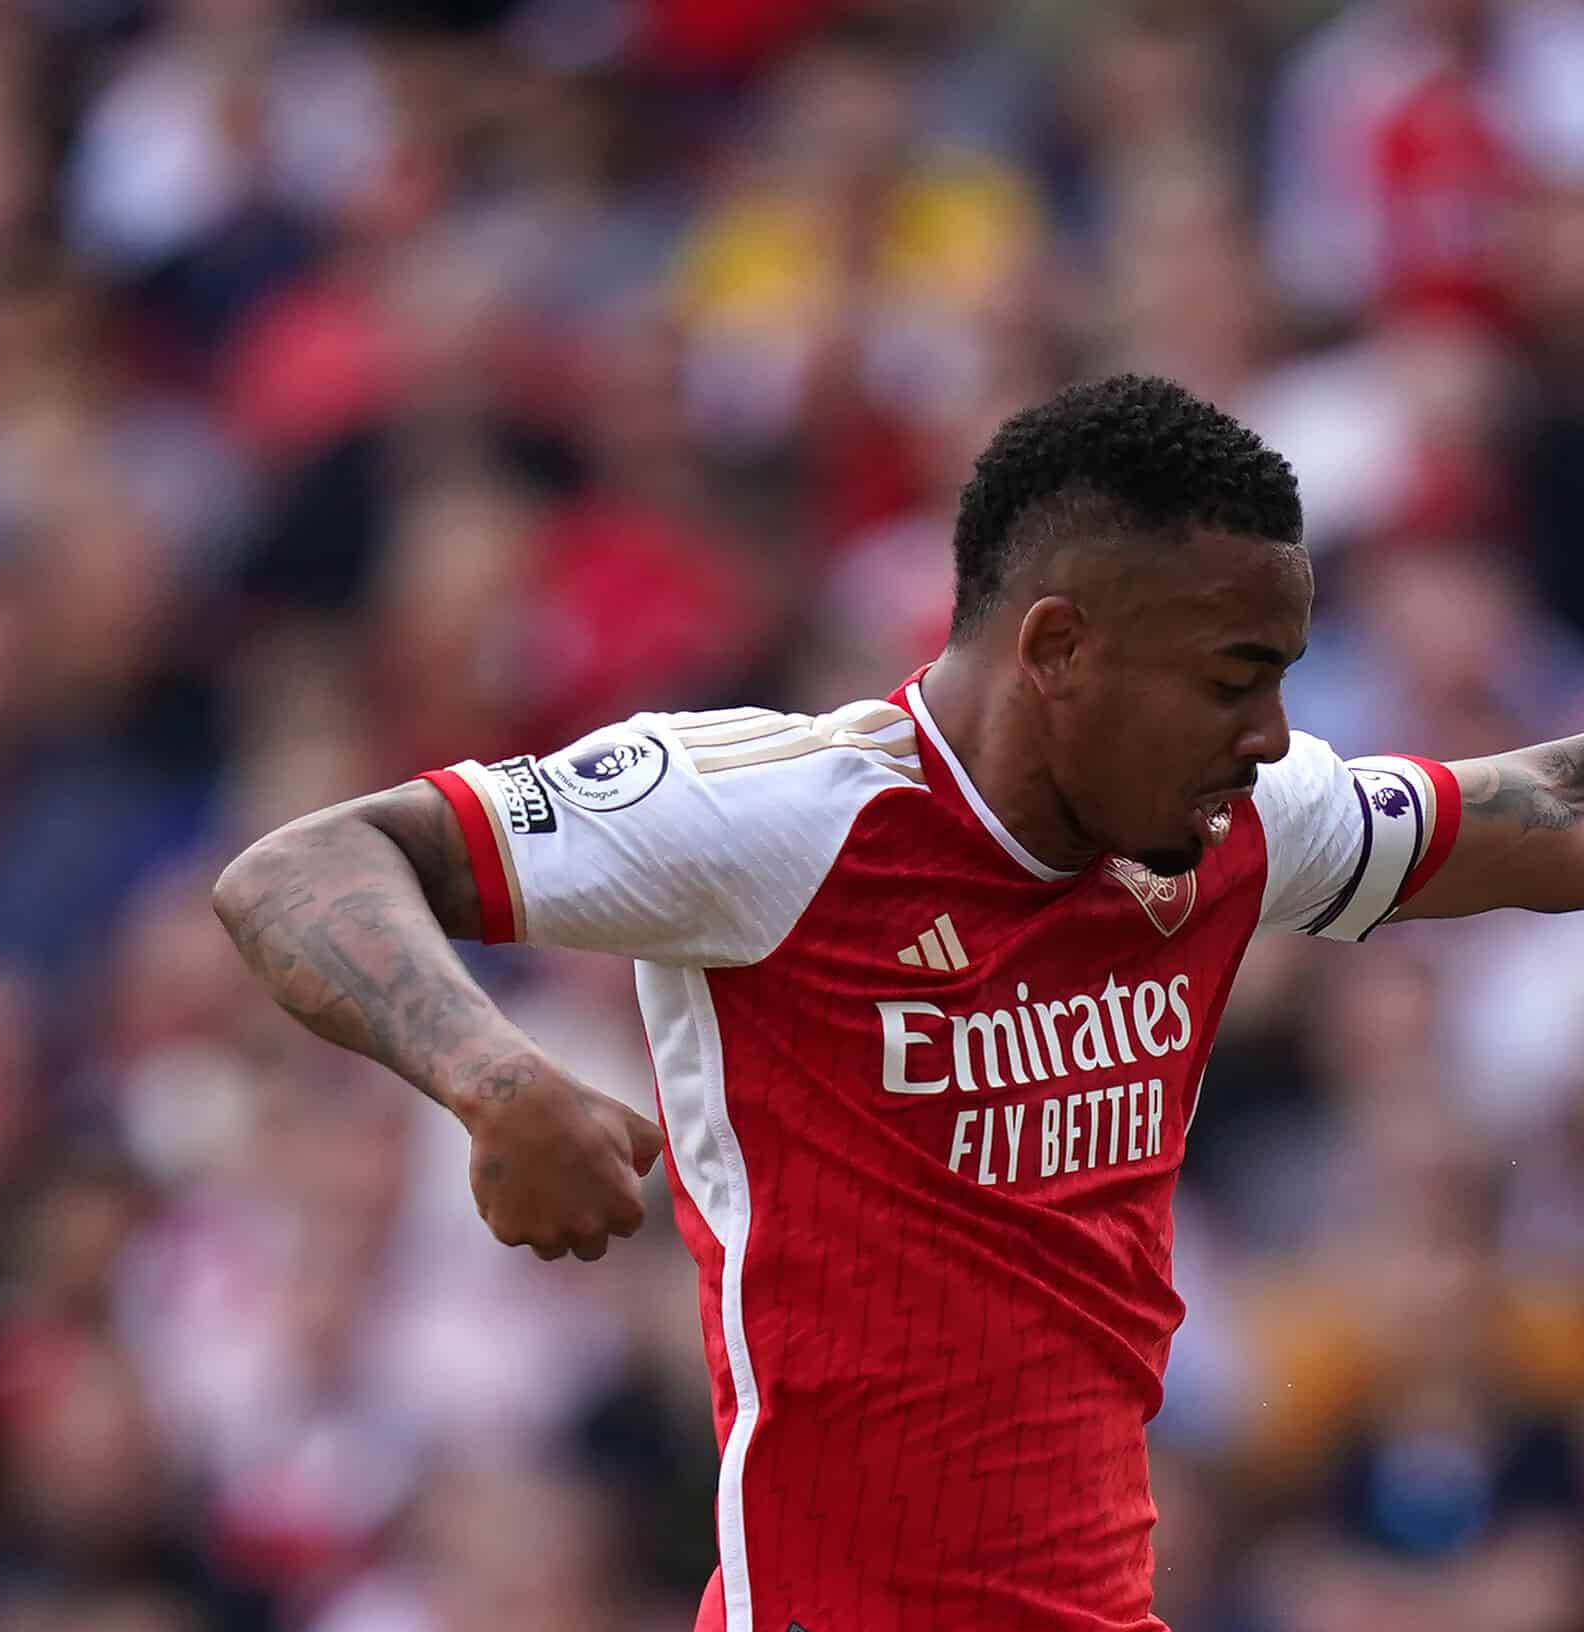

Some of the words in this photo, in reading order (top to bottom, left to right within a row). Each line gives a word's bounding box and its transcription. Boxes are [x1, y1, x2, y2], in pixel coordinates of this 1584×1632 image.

[508, 766, 549, 821] room
[578, 786, 619, 800] League
[875, 971, 1192, 1094] Emirates
[948, 1104, 1025, 1186] FLY
[1040, 1078, 1164, 1178] BETTER
